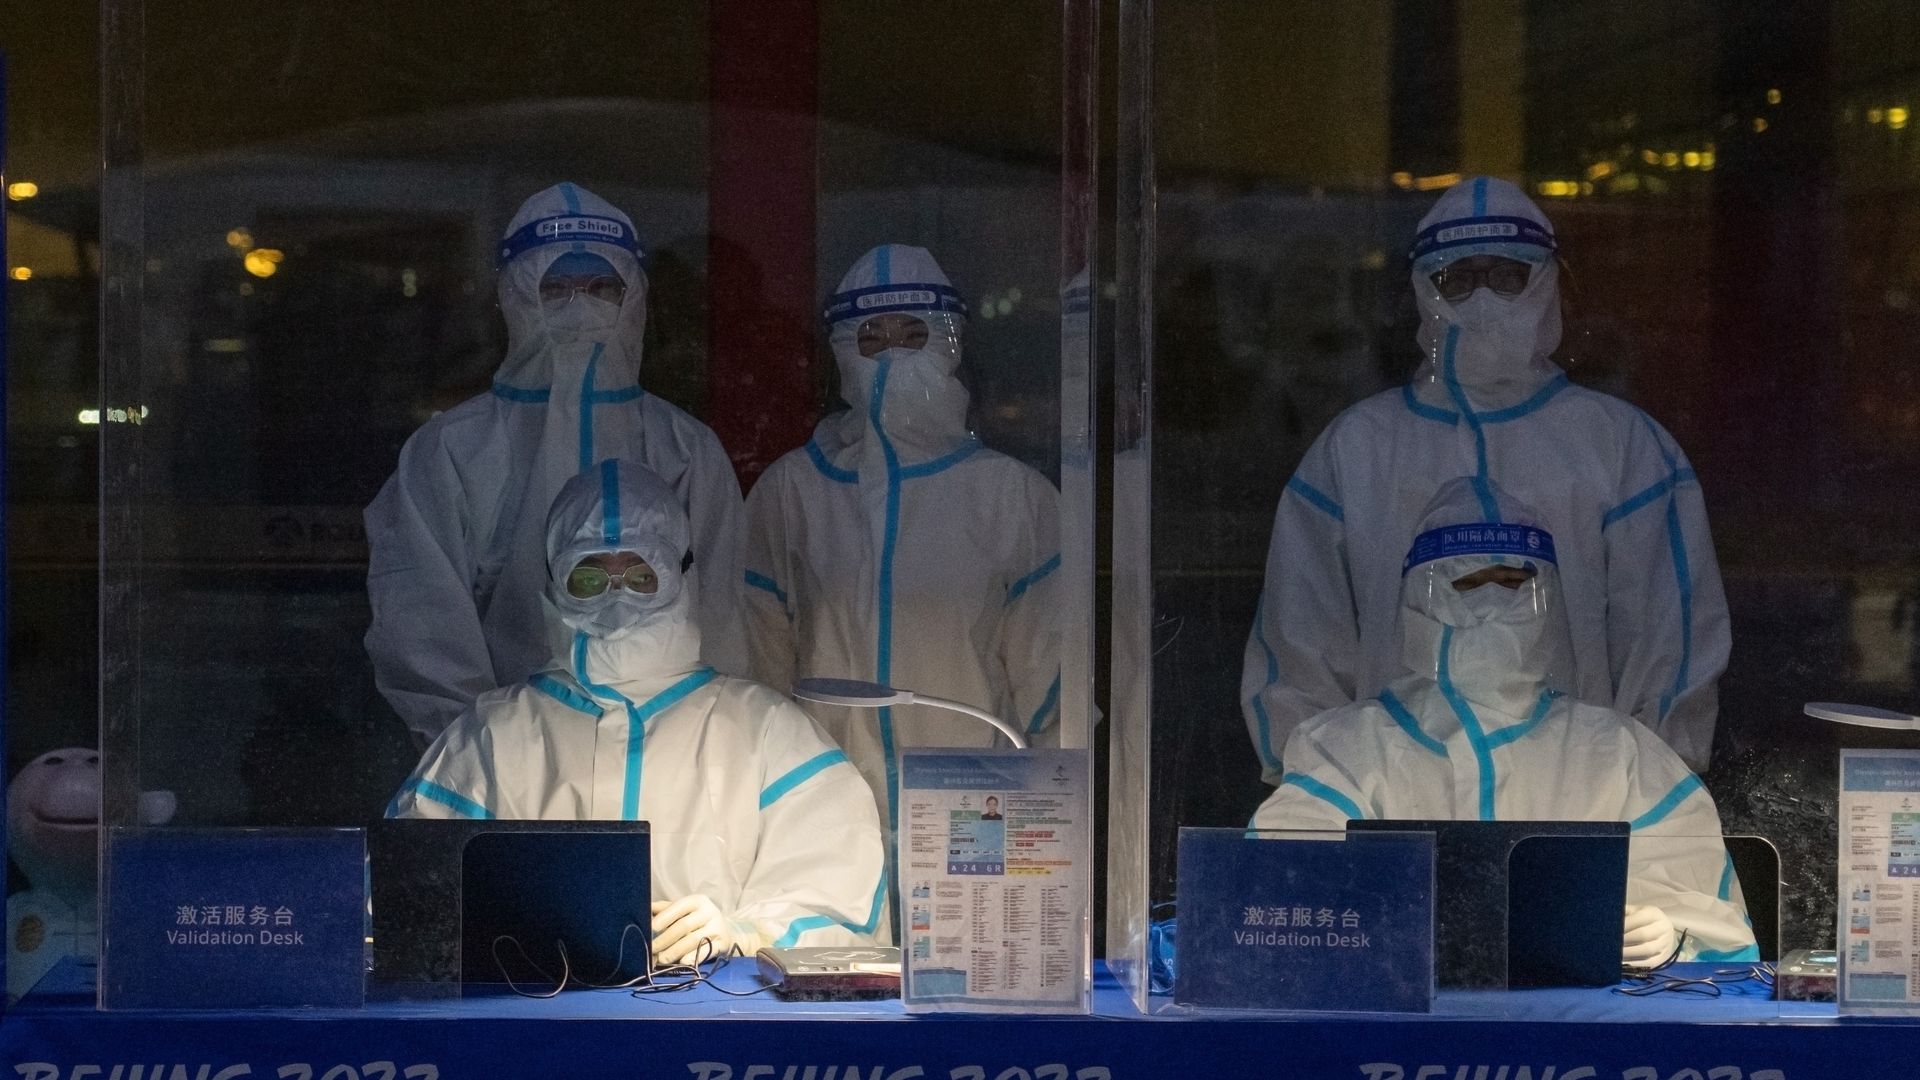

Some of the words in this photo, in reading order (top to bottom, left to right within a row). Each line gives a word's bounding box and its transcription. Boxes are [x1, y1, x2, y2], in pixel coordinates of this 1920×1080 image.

[542, 222, 572, 233] Face
[578, 220, 619, 234] Shield
[1444, 528, 1521, 544] 医用隔离面罩
[176, 905, 294, 926] 激活服务台
[1243, 906, 1361, 929] 激活服务台
[167, 930, 254, 945] Validation
[260, 930, 304, 945] Desk
[1234, 930, 1321, 946] Validation
[1327, 932, 1371, 948] Desk
